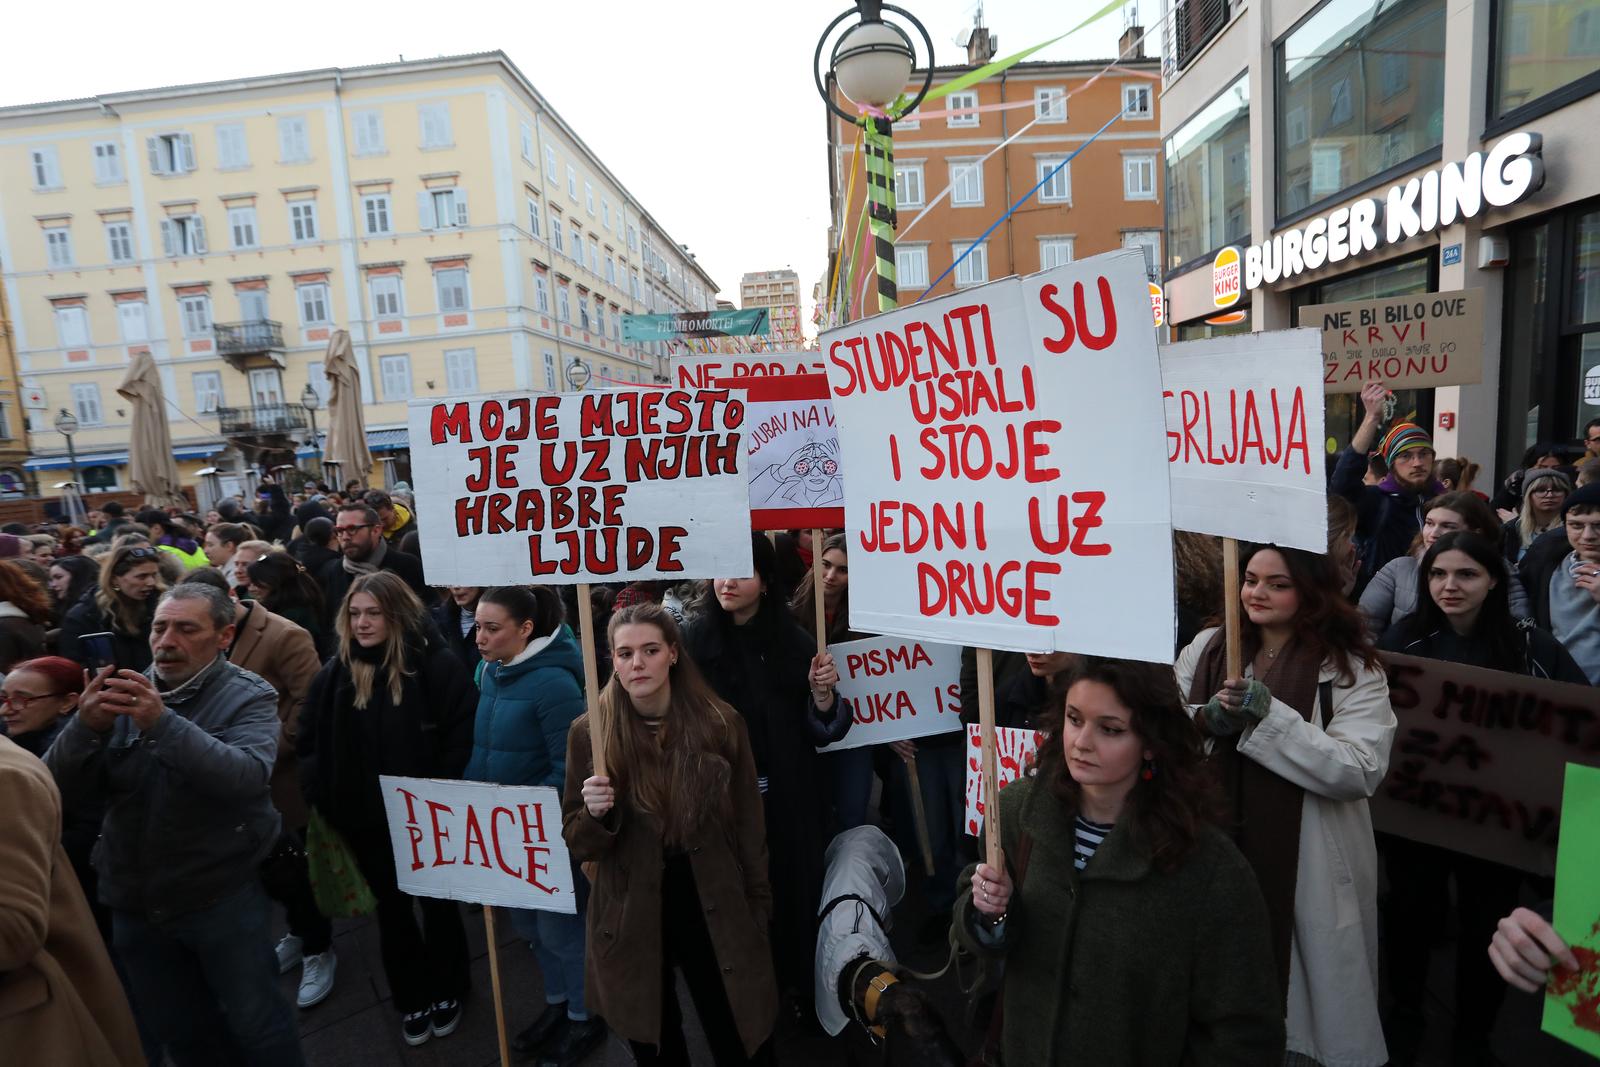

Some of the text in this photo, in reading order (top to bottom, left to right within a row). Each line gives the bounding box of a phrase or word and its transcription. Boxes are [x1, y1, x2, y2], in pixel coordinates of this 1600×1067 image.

[1245, 132, 1533, 290] BURGER KING
[1214, 264, 1239, 280] BURGER
[1214, 276, 1239, 296] KING
[657, 320, 687, 333] FIUME
[829, 276, 1118, 397] STUDENTI SU
[1323, 298, 1466, 331] NE BI BILO OVE
[1343, 321, 1425, 347] KRVI
[909, 365, 1036, 424] USTALI
[1324, 354, 1448, 384] ZAKONU
[430, 389, 744, 445] MOJE MJESTO
[792, 405, 820, 431] NA
[465, 433, 741, 492] JE UZ NJIH
[889, 420, 1062, 483] I STOJE
[455, 485, 628, 537] HRABRE
[859, 500, 987, 553] JEDNI
[528, 526, 688, 576] LJUDE
[916, 558, 1062, 627] DRUGE
[846, 643, 934, 679] PISMA
